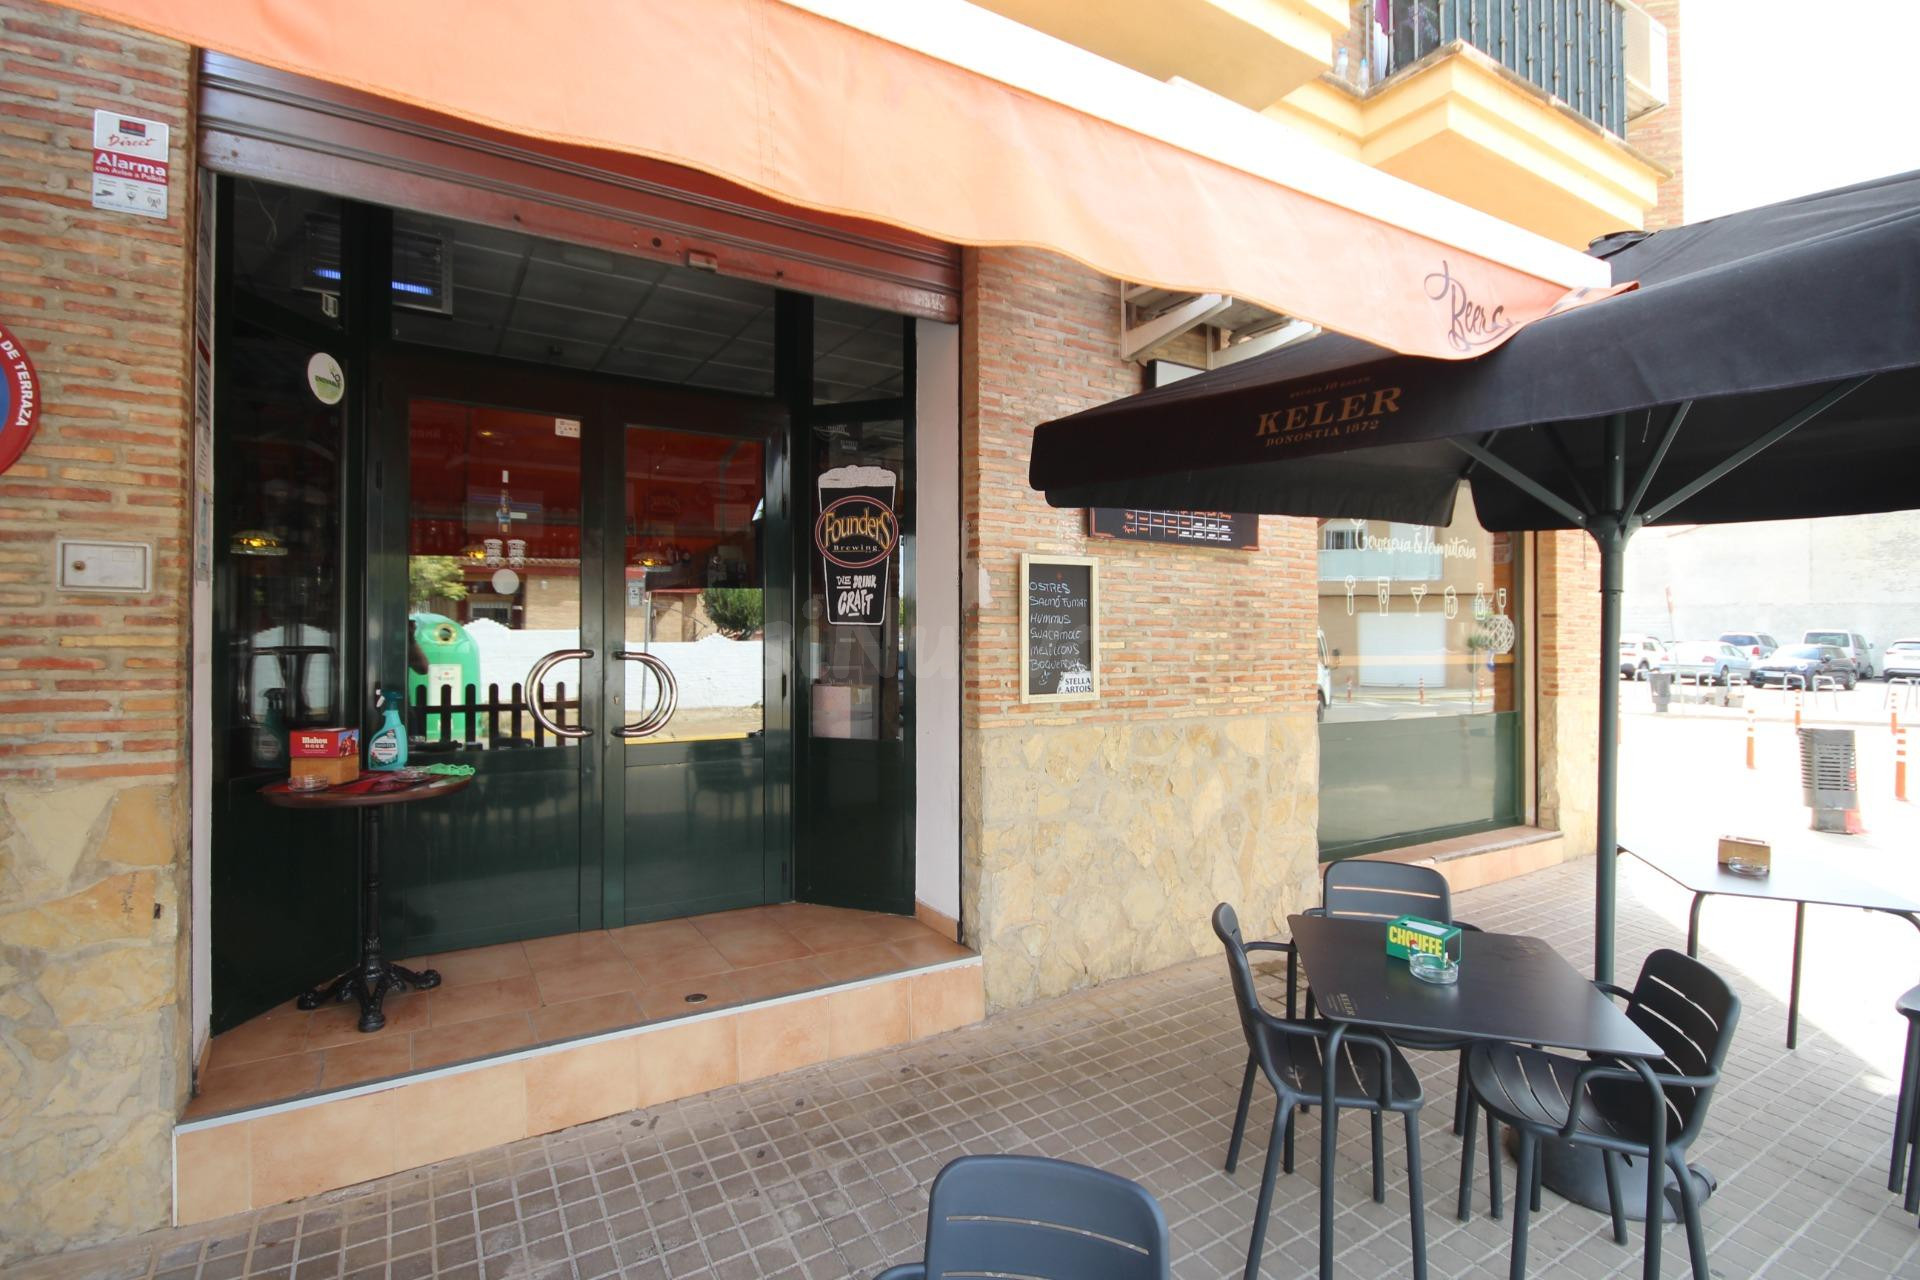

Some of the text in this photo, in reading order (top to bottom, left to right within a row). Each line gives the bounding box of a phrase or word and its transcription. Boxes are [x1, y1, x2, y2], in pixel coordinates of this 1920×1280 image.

[96, 153, 166, 177] Alarma
[1, 340, 33, 426] DE TERRAZA
[1256, 386, 1402, 437] KELER
[1265, 427, 1341, 448] DONOSTIA
[834, 544, 878, 553] Brewing
[836, 574, 877, 589] WE DRINK
[1029, 581, 1071, 594] OSTRES
[837, 589, 874, 616] CRAFT
[1030, 613, 1072, 624] HUMMUS
[1064, 677, 1091, 686] STELLA
[1064, 685, 1092, 693] ARTOIS
[302, 736, 328, 744] Mahou
[1388, 925, 1443, 957] CHOUFFE
